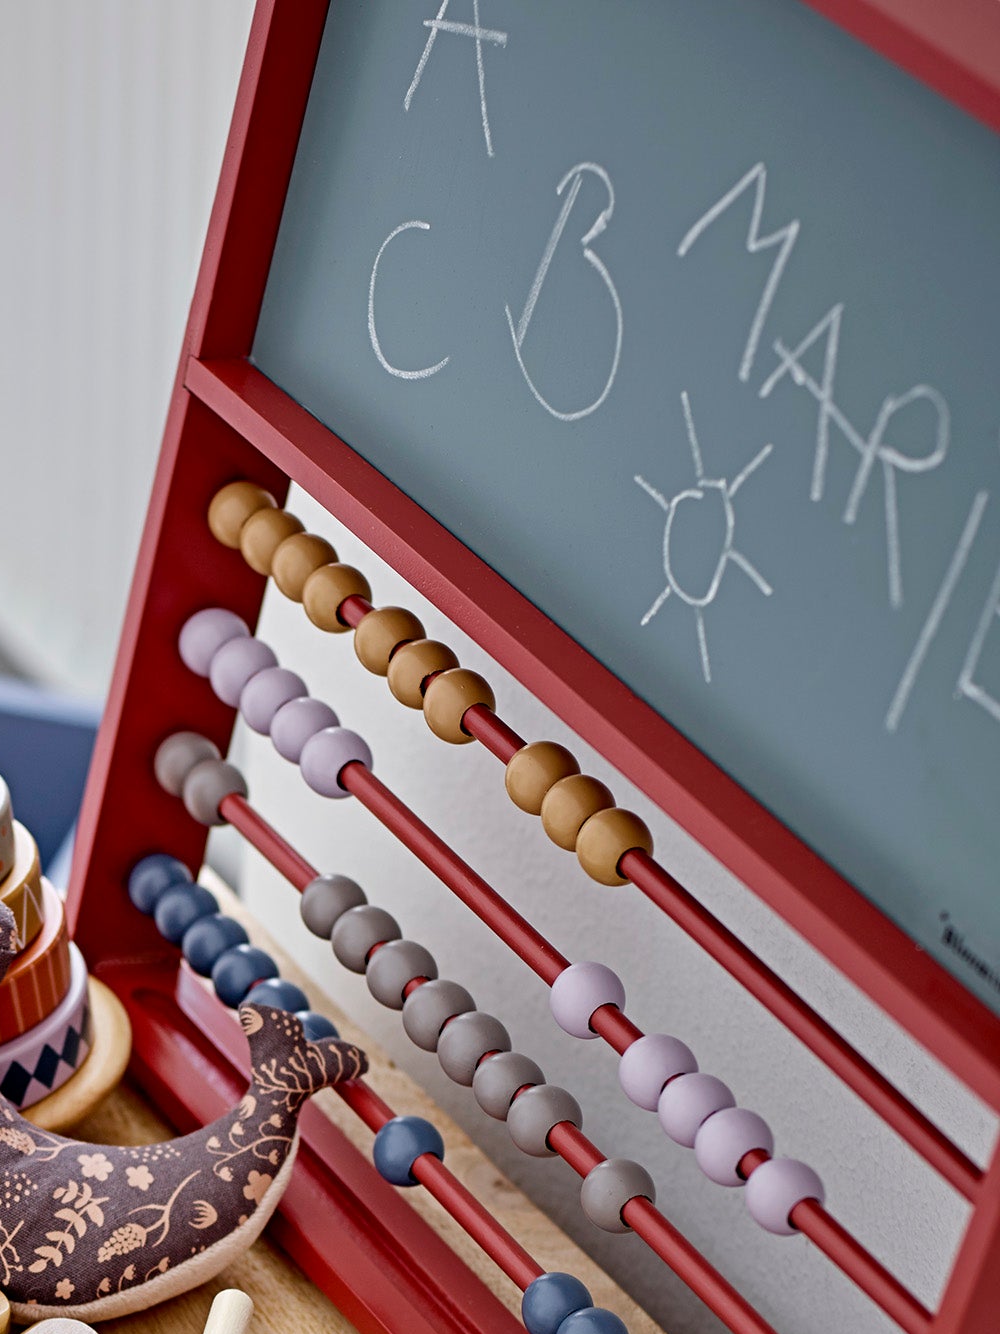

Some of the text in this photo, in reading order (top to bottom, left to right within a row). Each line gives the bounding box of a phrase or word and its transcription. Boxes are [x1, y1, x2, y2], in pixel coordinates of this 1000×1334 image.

[404, 0, 508, 157] A
[368, 220, 449, 380] C
[505, 162, 623, 421] B
